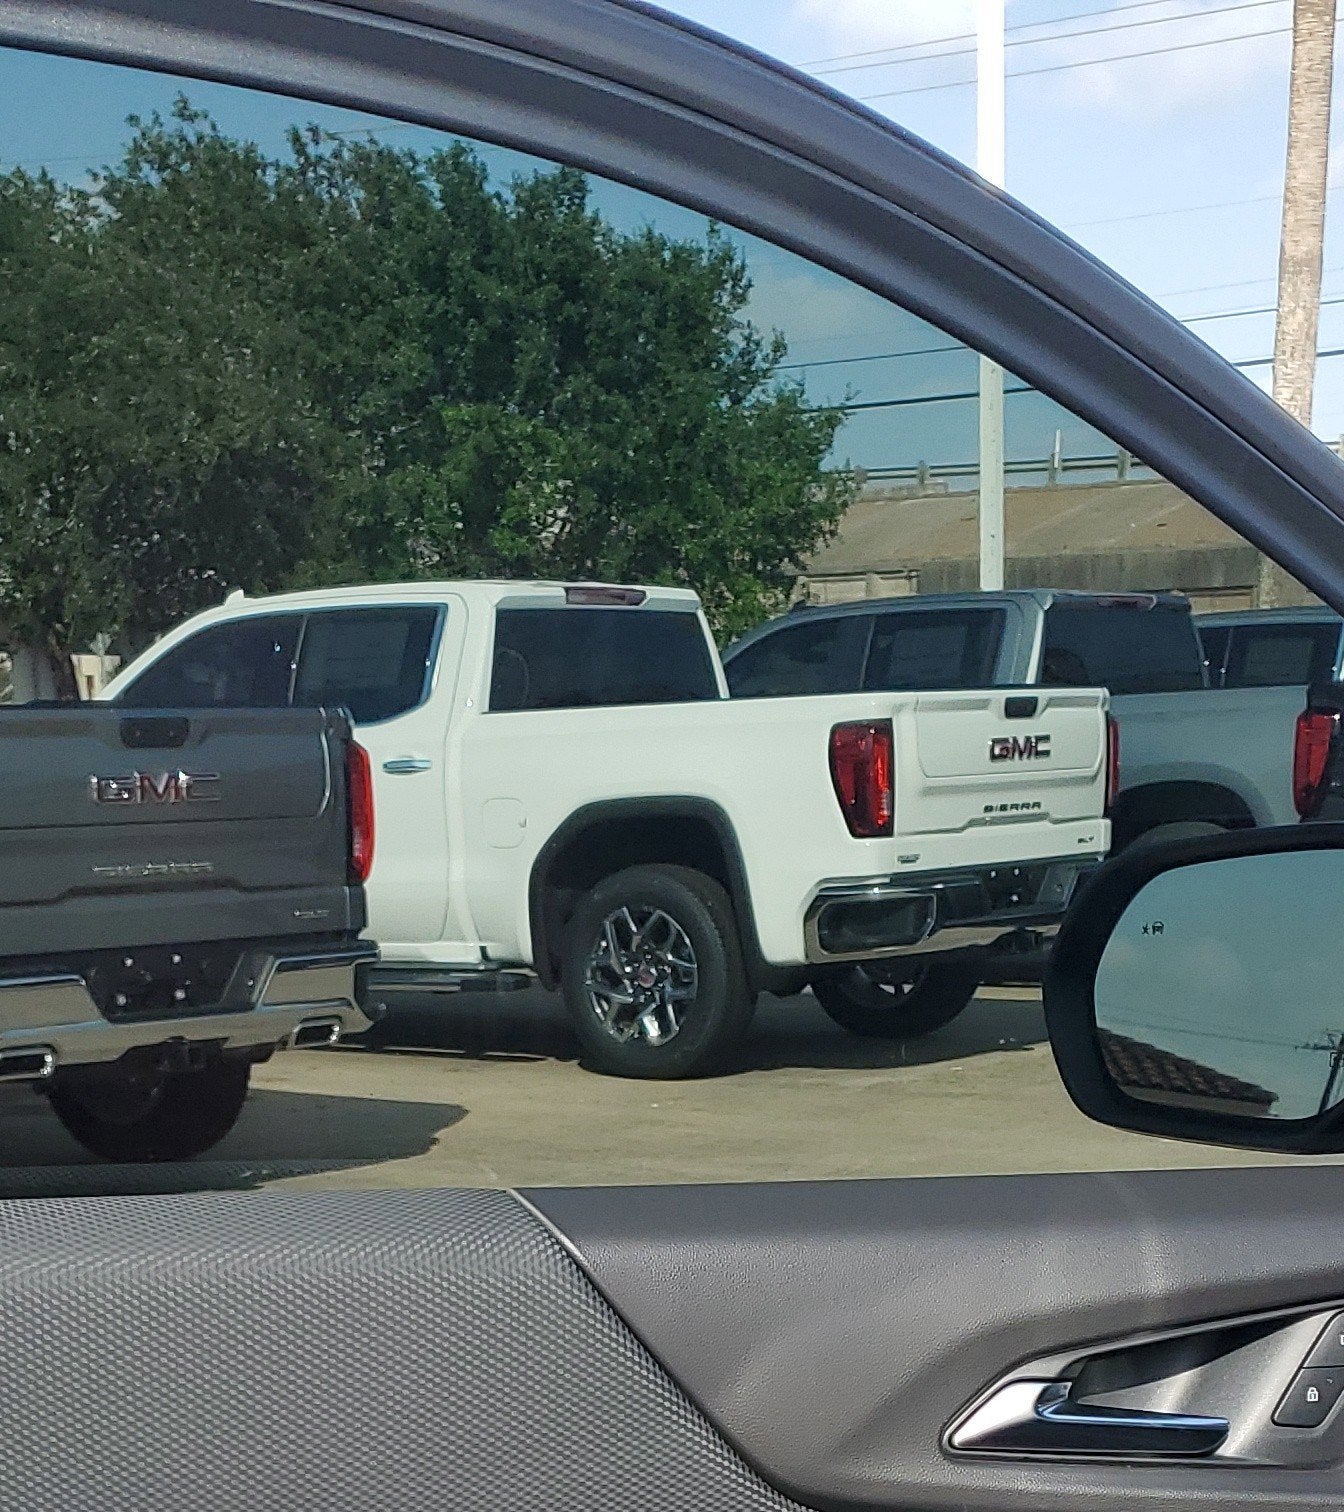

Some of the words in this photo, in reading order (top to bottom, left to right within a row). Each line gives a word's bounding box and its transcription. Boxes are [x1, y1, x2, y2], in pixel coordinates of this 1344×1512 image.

[989, 734, 1051, 762] GMC
[89, 770, 220, 804] GMC
[983, 801, 1042, 813] SIERRA
